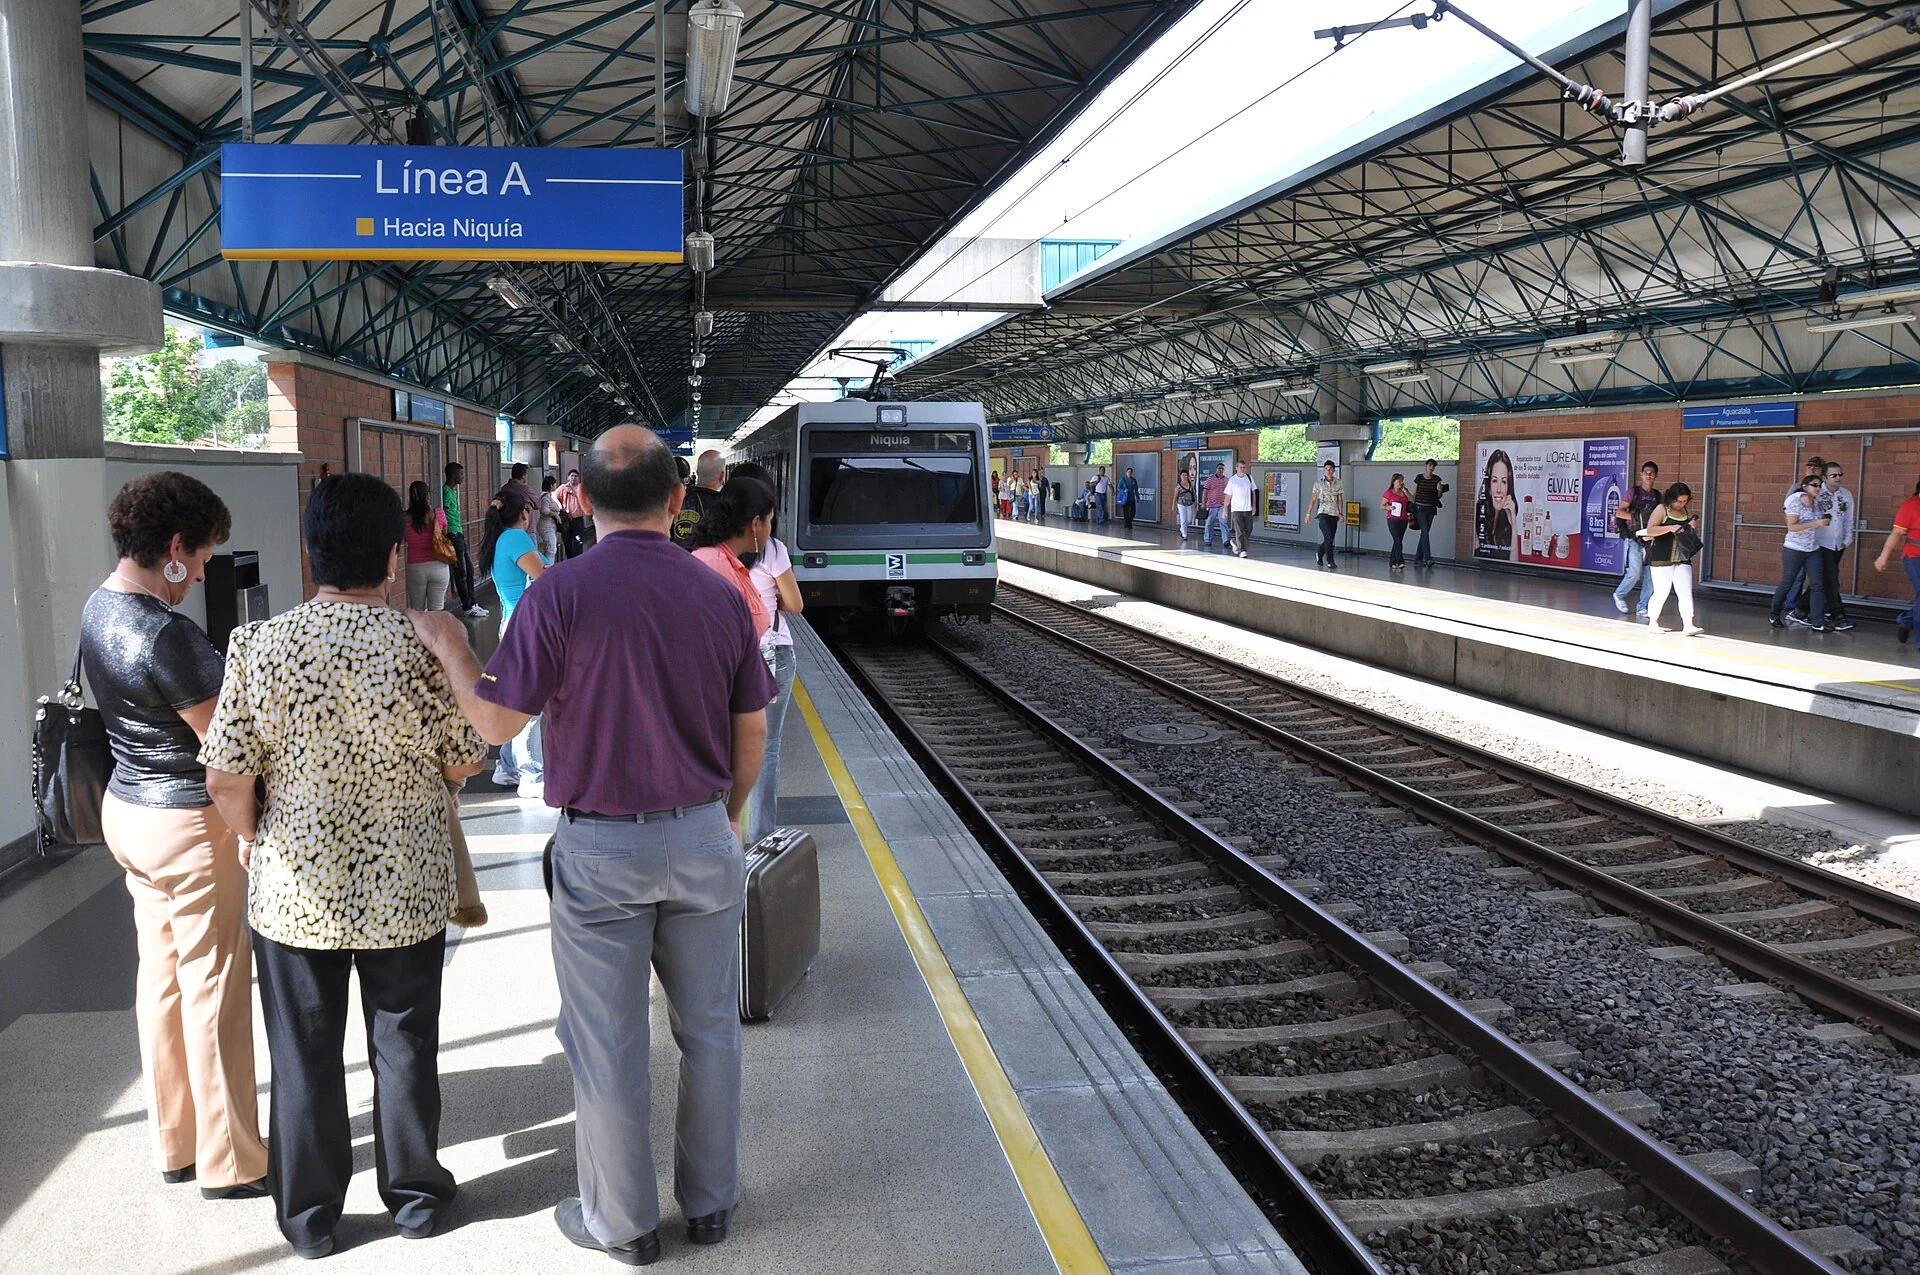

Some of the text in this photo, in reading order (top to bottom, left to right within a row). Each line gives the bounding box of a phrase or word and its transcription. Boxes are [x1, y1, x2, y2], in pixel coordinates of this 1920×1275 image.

[375, 159, 531, 197] Línea A
[383, 217, 523, 242] Hacia Niquía
[1722, 408, 1751, 417] Aguacatala
[1547, 478, 1579, 493] ELVIVE
[1589, 517, 1604, 527] 8 hrs
